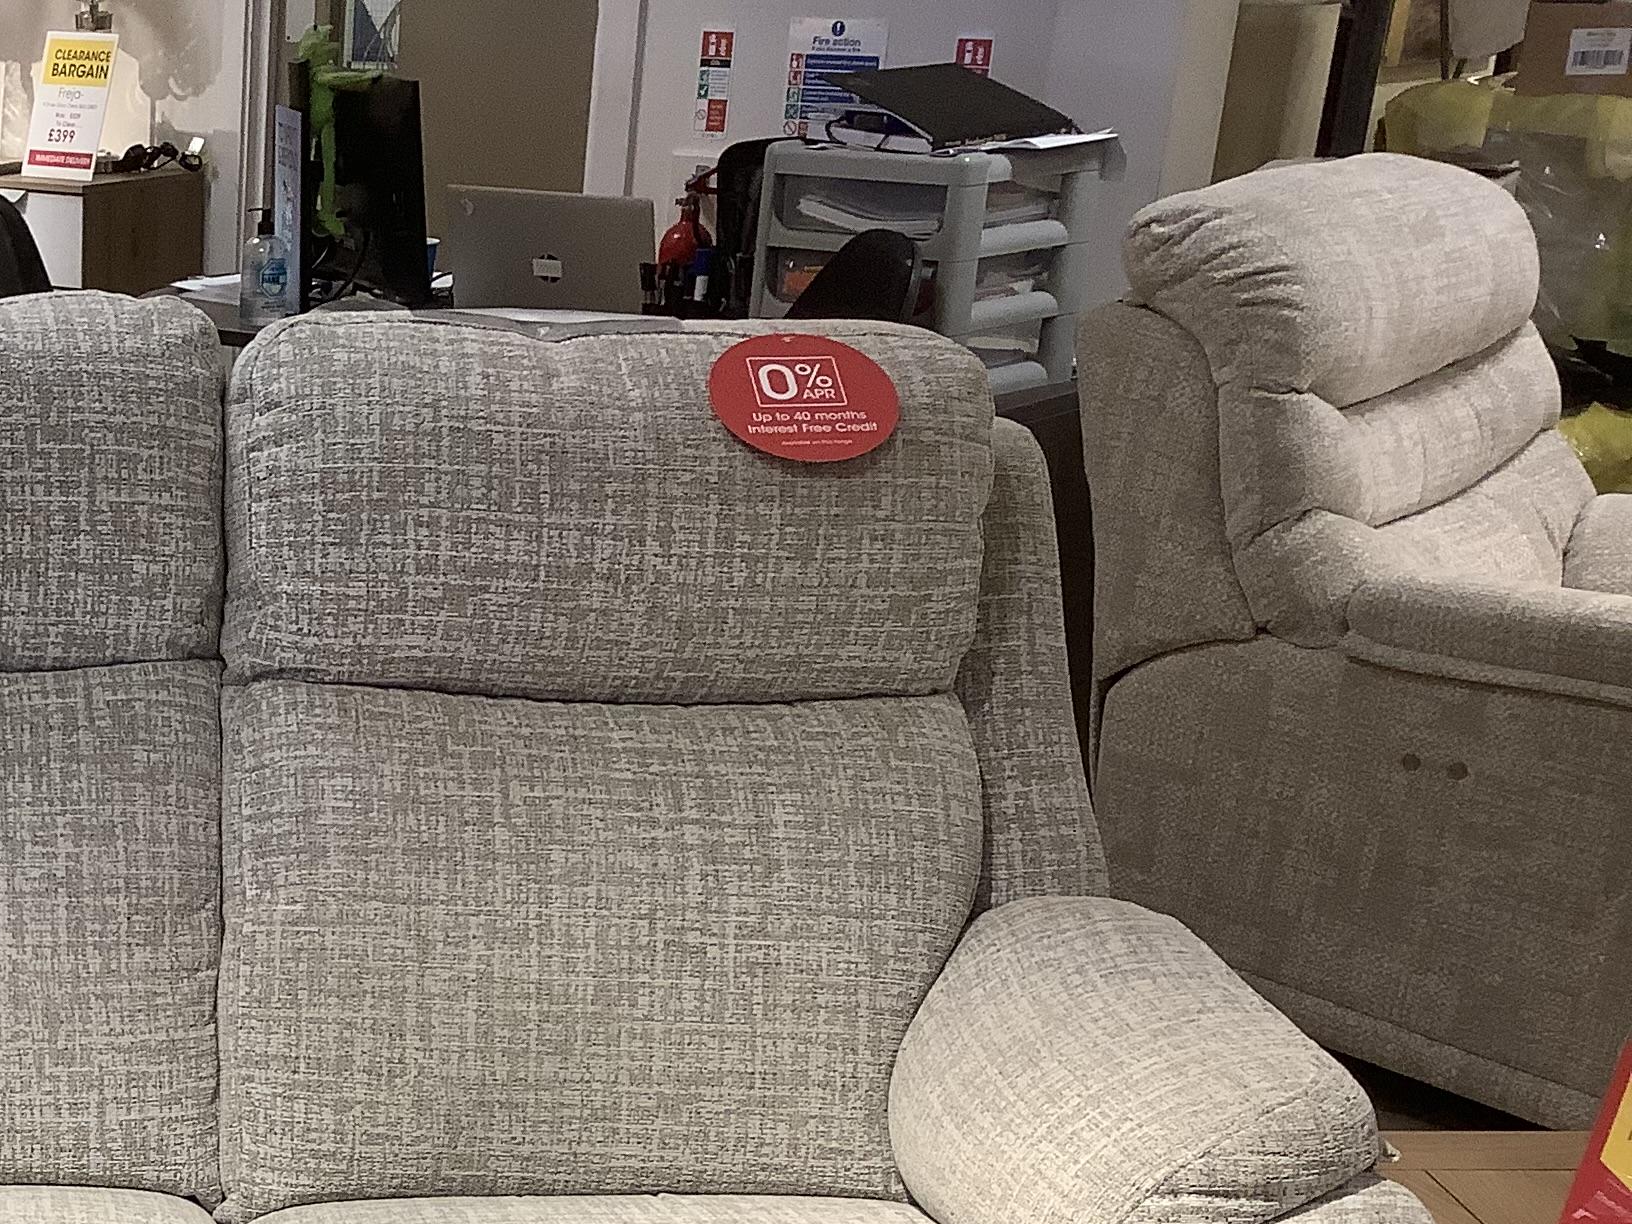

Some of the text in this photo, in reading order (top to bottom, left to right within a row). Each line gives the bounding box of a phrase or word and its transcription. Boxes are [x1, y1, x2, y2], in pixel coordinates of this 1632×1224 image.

[832, 37, 862, 47] action
[55, 49, 112, 62] CLEARANCE
[52, 63, 110, 79] BARGAIN
[48, 129, 76, 143] £399
[758, 363, 833, 400] 0%
[802, 388, 836, 400] APR
[752, 410, 867, 423] Up to 40 months
[747, 421, 878, 434] Interest Free Credit
